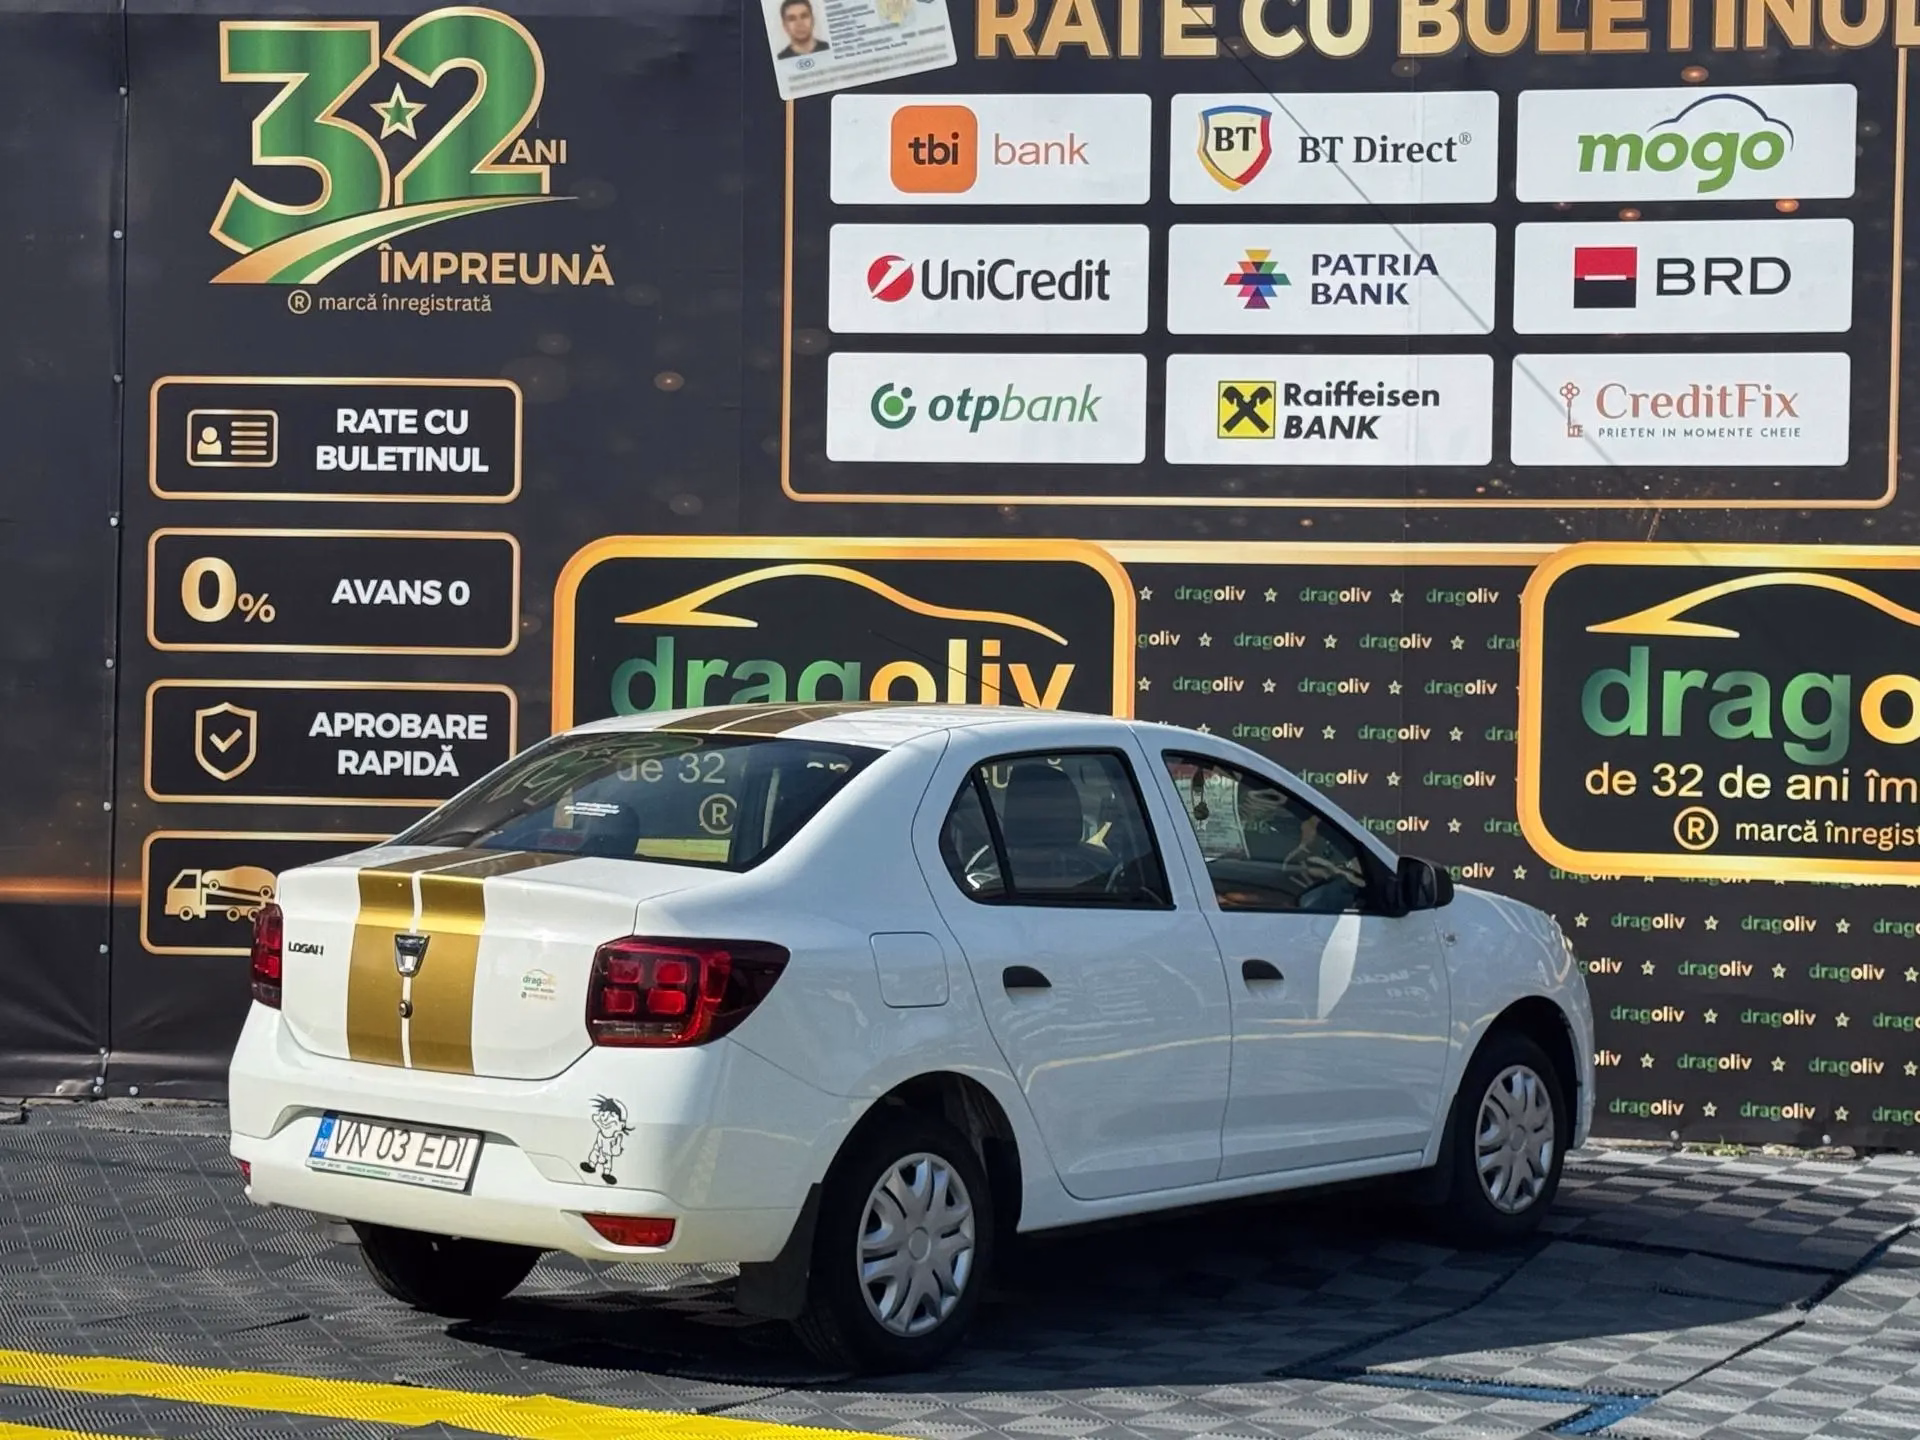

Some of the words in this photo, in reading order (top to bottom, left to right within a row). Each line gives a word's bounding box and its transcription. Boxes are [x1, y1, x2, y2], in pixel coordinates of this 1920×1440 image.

[974, 0, 1219, 59] RATE
[1239, 0, 1373, 59] CU
[210, 6, 550, 254] 32
[1213, 127, 1257, 152] BT
[509, 141, 568, 165] ANI
[907, 132, 959, 166] tbi
[994, 133, 1088, 165] bank
[1298, 135, 1343, 164] BT
[1578, 131, 1786, 194] mogo
[379, 243, 614, 286] ÎMPREUNĂ
[1311, 254, 1440, 276] PATRIA
[1656, 256, 1792, 297] BRD
[921, 258, 1110, 301] UniCredit
[318, 292, 378, 311] marcă
[381, 292, 492, 316] înregistrată
[1311, 282, 1410, 306] BANK
[928, 383, 1102, 433] otpbank
[1283, 381, 1440, 408] Raiffeisen
[1596, 383, 1799, 419] CreditFix
[337, 408, 418, 434] RATE
[424, 408, 469, 435] CU
[1282, 414, 1380, 441] BANK
[1598, 428, 1655, 438] PRIETEN
[1662, 428, 1677, 438] IN
[1683, 428, 1753, 438] MOMENTE
[1760, 428, 1801, 438] CHEIE
[315, 445, 489, 473] BULETINUL
[331, 579, 442, 606] AVANS
[448, 580, 471, 606] 0
[1174, 586, 1246, 604] dragoliv
[1299, 587, 1372, 605] dragoliv
[1426, 588, 1500, 606] dragoliv
[1233, 632, 1306, 650] dragoliv
[1360, 633, 1433, 651] dragoliv
[1172, 676, 1245, 694] dragoliv
[1298, 678, 1371, 696] dragoliv
[1424, 679, 1498, 698] dragoliv
[308, 712, 488, 740] APROBARE
[1232, 723, 1305, 741] dragoliv
[1358, 725, 1431, 743] dragoliv
[337, 744, 460, 778] RAPIDĂ
[678, 752, 726, 784] 32
[1423, 771, 1497, 789] dragoliv
[1584, 761, 1638, 797] de
[1651, 762, 1704, 798] 32
[1718, 764, 1772, 799] de
[1785, 767, 1851, 802] ani
[1735, 819, 1819, 844] marcă
[1611, 913, 1686, 932] dragoliv
[1741, 915, 1817, 934] dragoliv
[1678, 960, 1754, 979] dragoliv
[1809, 964, 1886, 982] dragoliv
[1610, 1005, 1685, 1024] dragoliv
[1741, 1008, 1816, 1027] dragoliv
[1677, 1053, 1753, 1072] dragoliv
[1808, 1058, 1885, 1077] dragoliv
[1609, 1098, 1685, 1118] dragoliv
[1740, 1102, 1816, 1121] dragoliv
[334, 1119, 374, 1158] VN
[376, 1127, 411, 1162] 03
[415, 1132, 469, 1173] EDI
